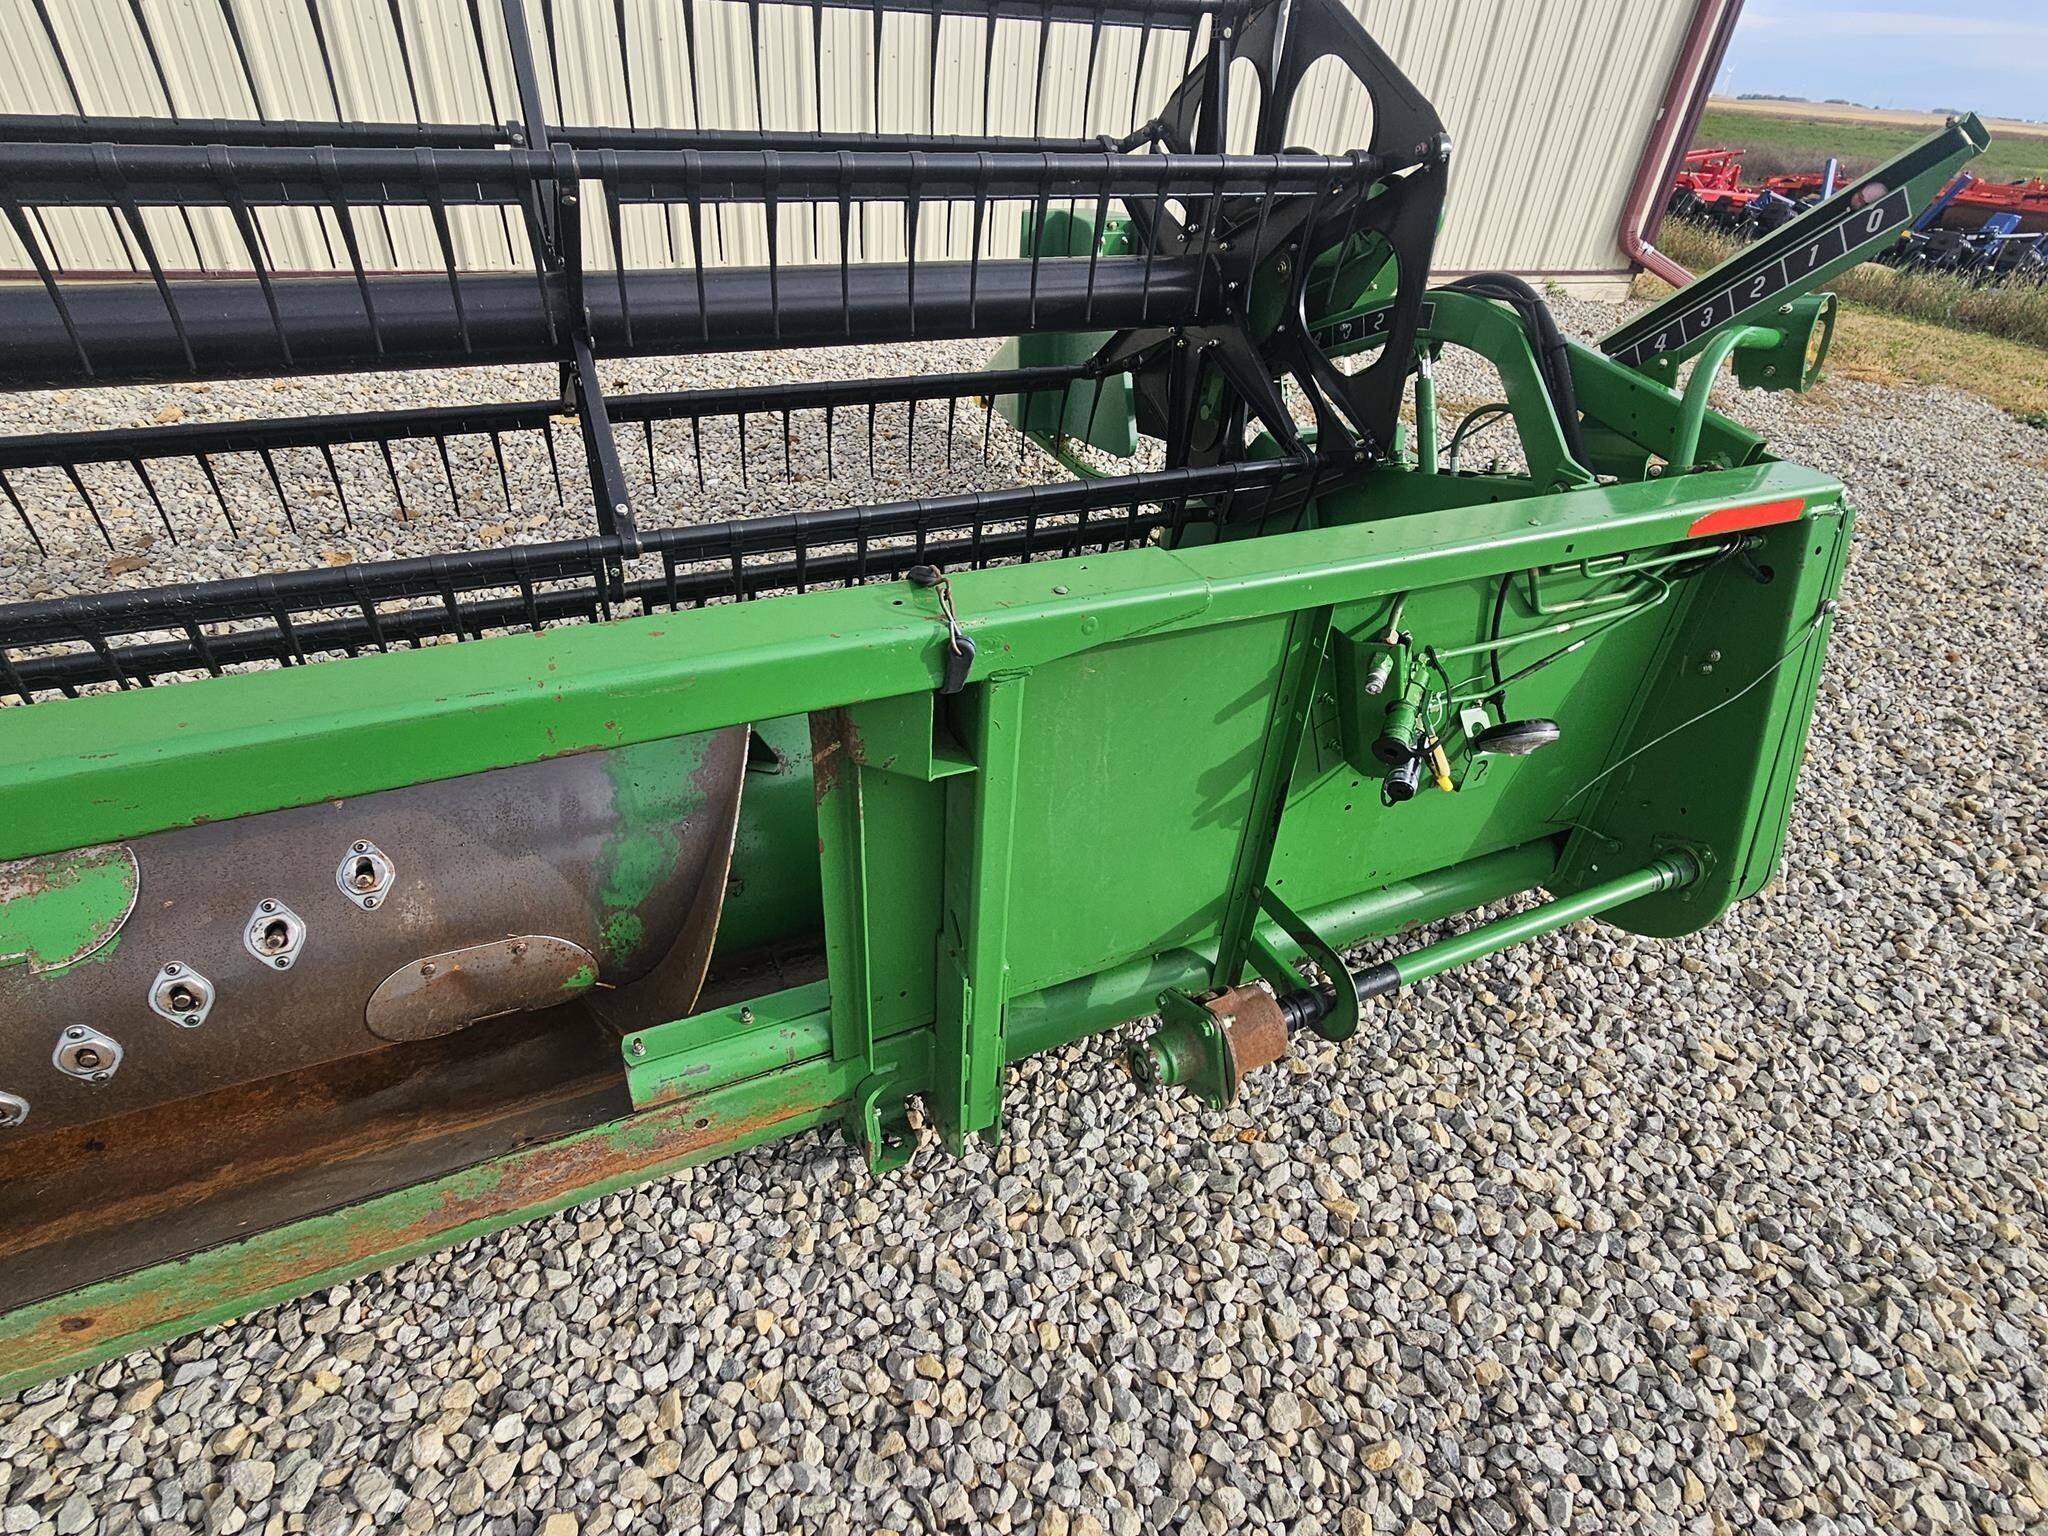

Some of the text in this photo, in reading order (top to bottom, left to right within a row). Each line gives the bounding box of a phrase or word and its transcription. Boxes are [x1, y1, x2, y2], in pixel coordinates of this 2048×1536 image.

[1654, 208, 1883, 352] 4 3 2 1 0
[1374, 313, 1385, 330] 2
